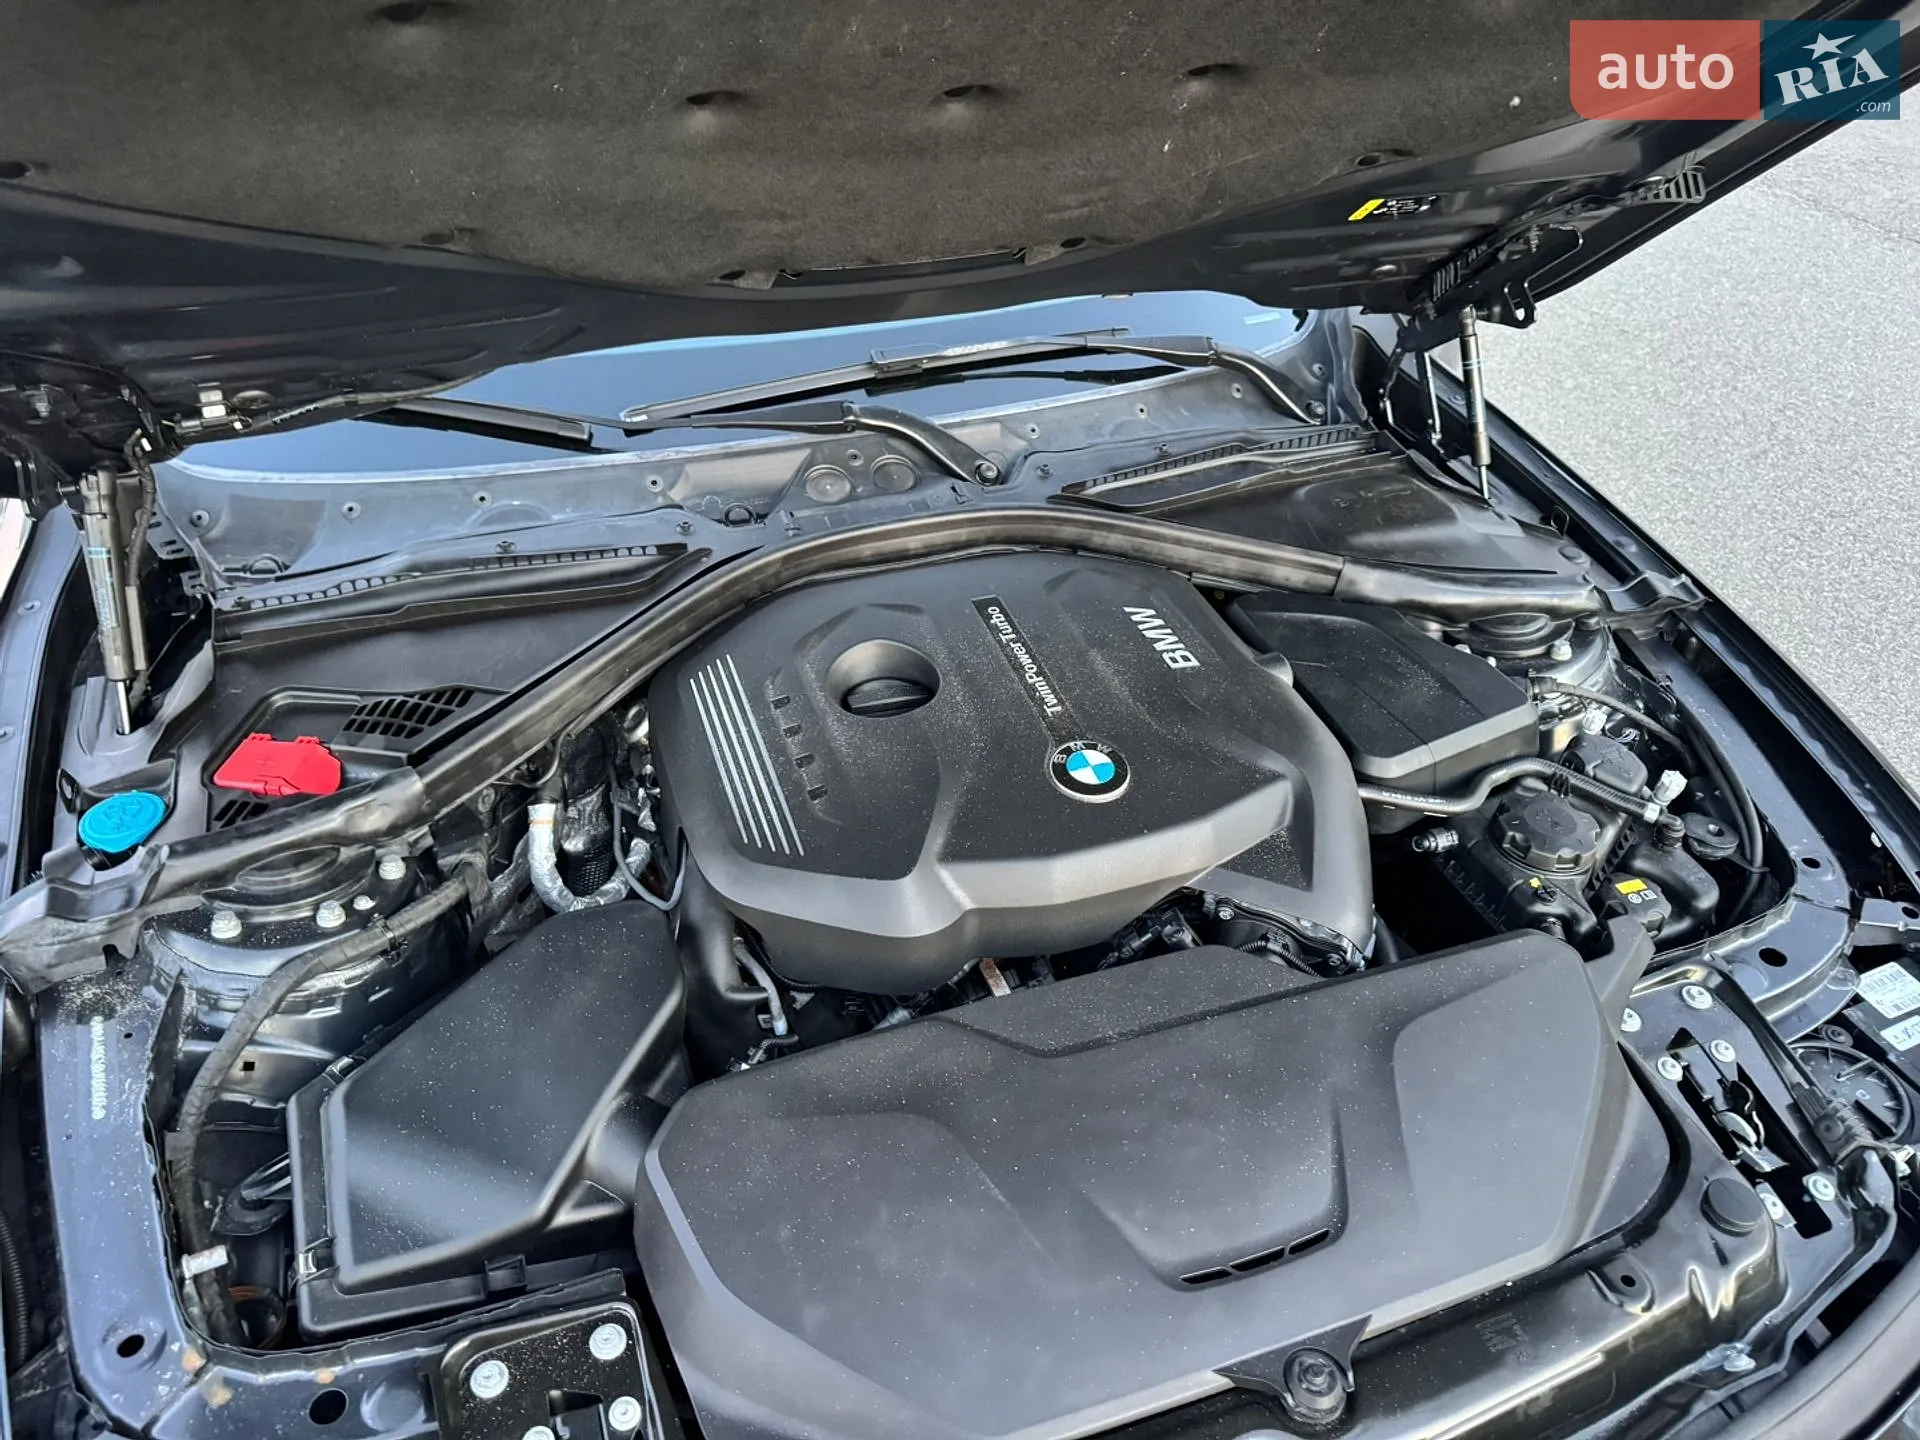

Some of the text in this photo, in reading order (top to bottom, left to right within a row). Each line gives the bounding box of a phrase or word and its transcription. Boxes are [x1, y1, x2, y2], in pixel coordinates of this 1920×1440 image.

[987, 606, 1062, 716] TwinPower Turbo
[1123, 606, 1201, 670] BMW
